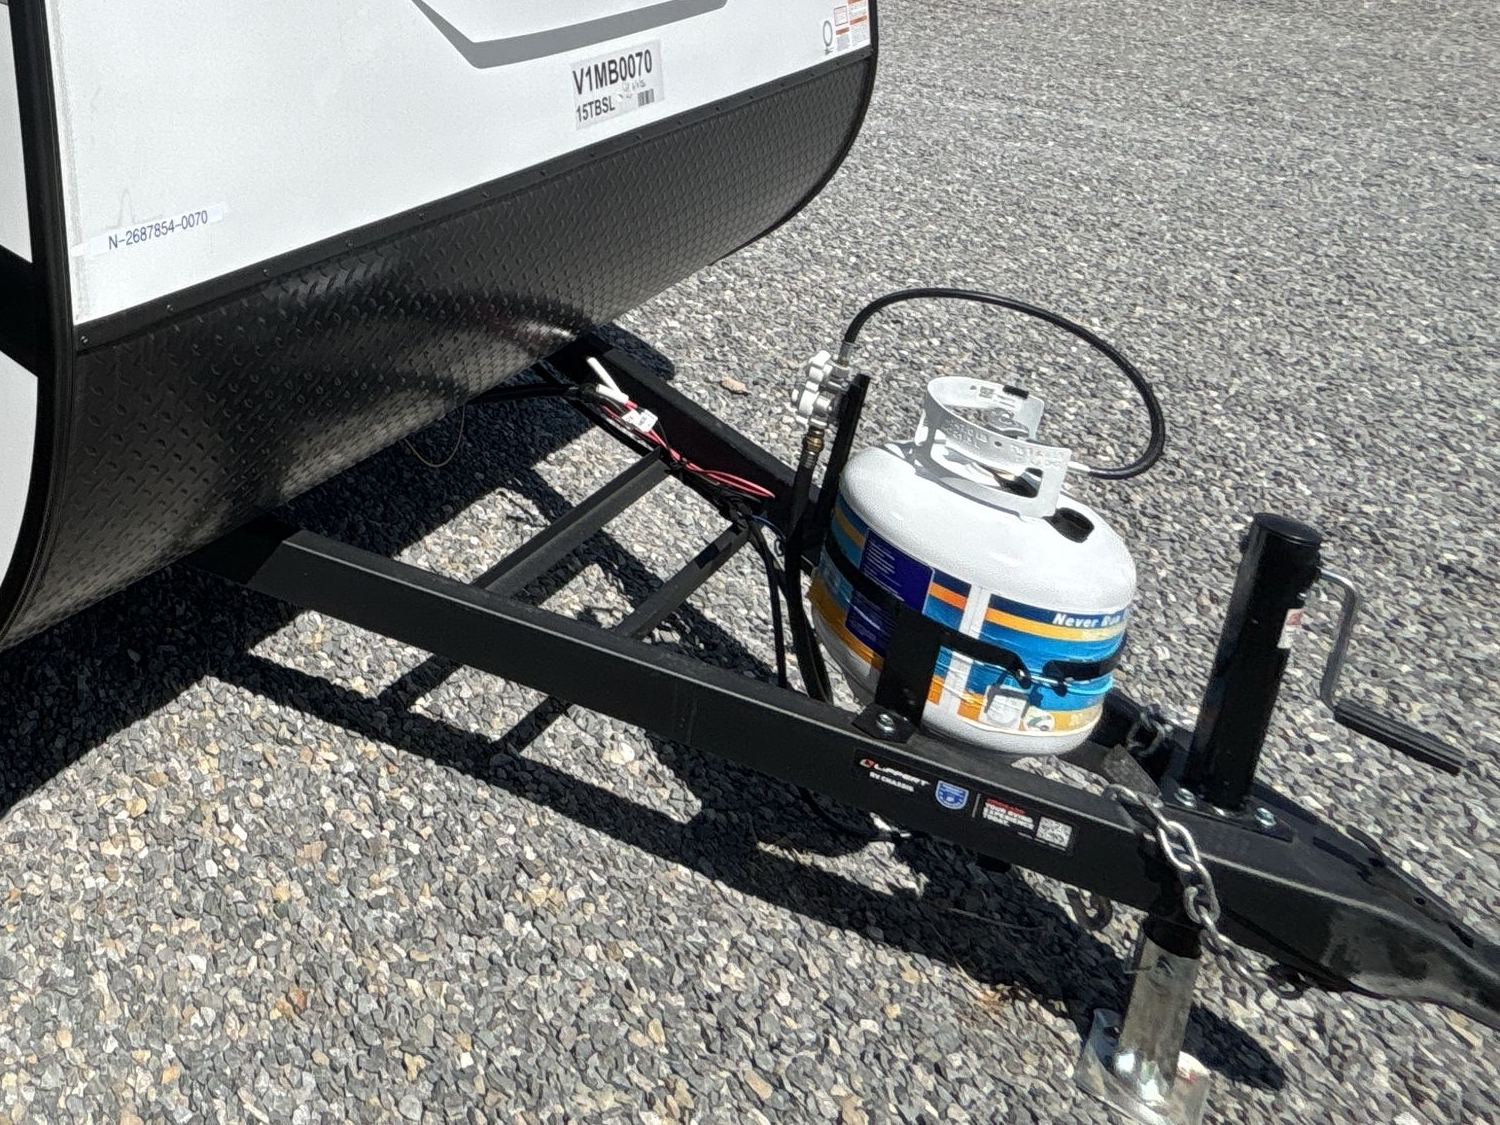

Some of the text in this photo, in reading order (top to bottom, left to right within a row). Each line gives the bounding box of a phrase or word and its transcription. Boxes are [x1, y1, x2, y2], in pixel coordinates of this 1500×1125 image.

[572, 49, 653, 95] V1MB0070
[576, 95, 616, 122] 15TBSL
[108, 210, 208, 250] N-2687854-0070
[1052, 613, 1100, 628] Never
